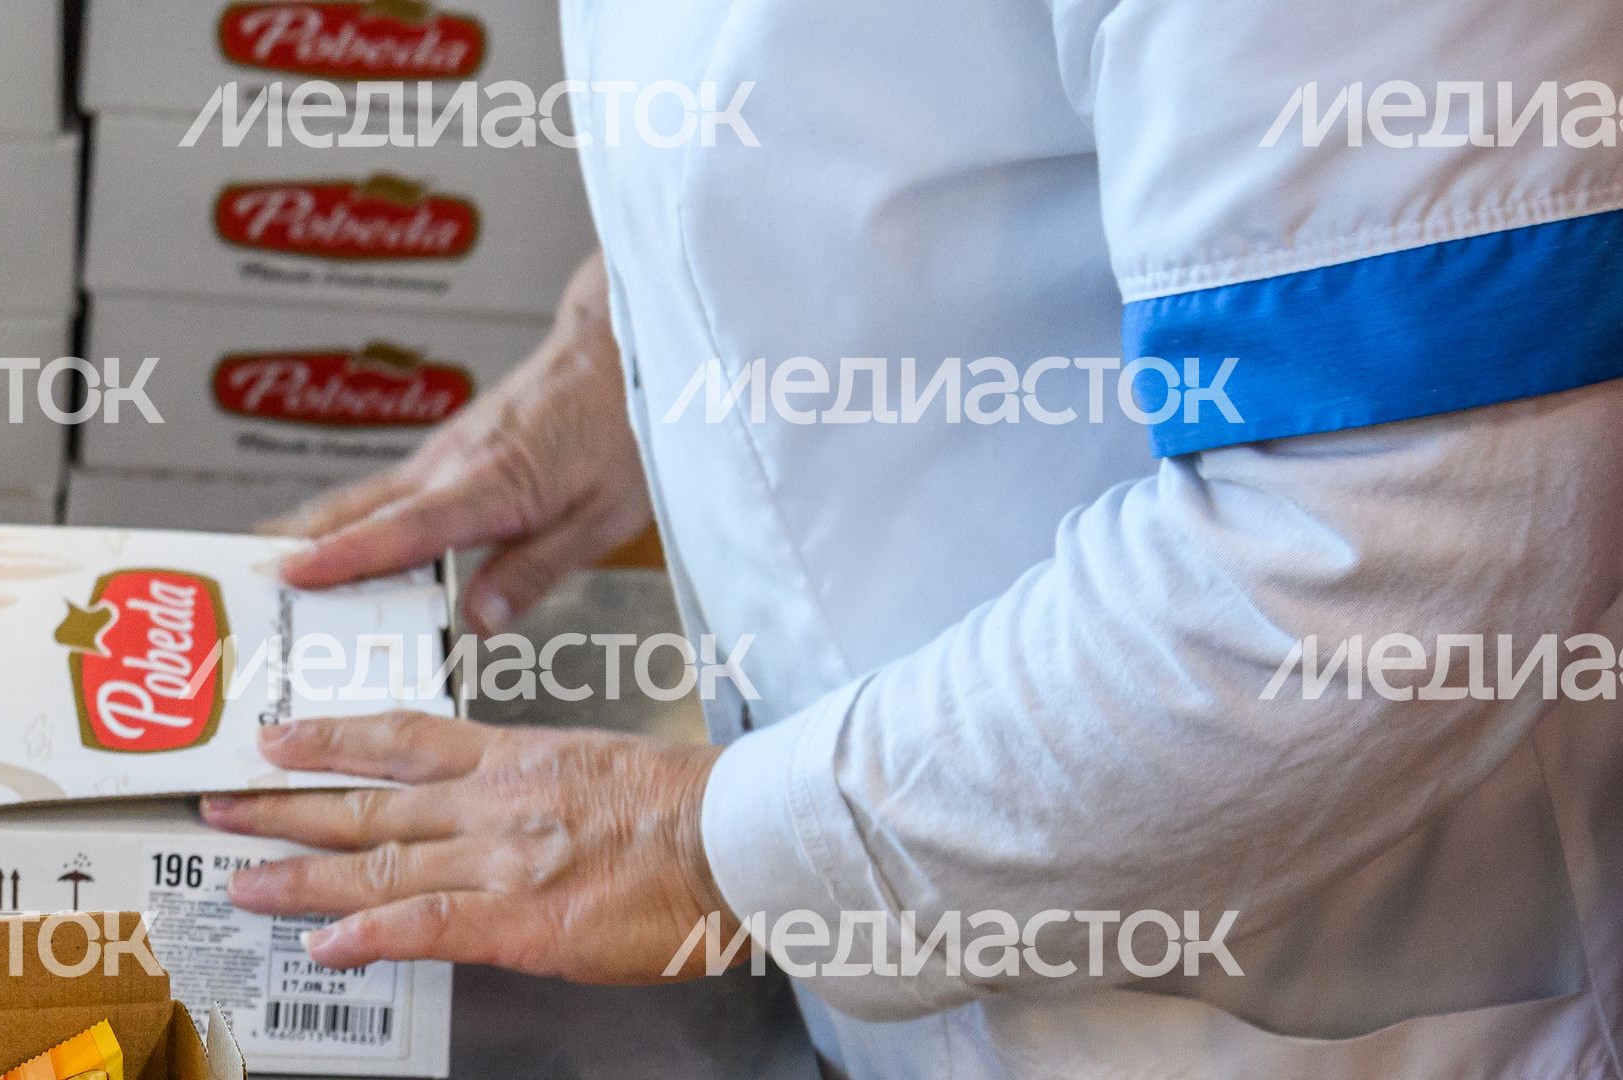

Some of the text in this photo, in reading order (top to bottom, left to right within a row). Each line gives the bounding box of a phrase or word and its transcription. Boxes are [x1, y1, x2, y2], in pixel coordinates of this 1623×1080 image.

[233, 10, 465, 73] Pobeda
[231, 185, 459, 255] Pobeda
[96, 580, 197, 739] Pobeda
[152, 853, 203, 888] 196
